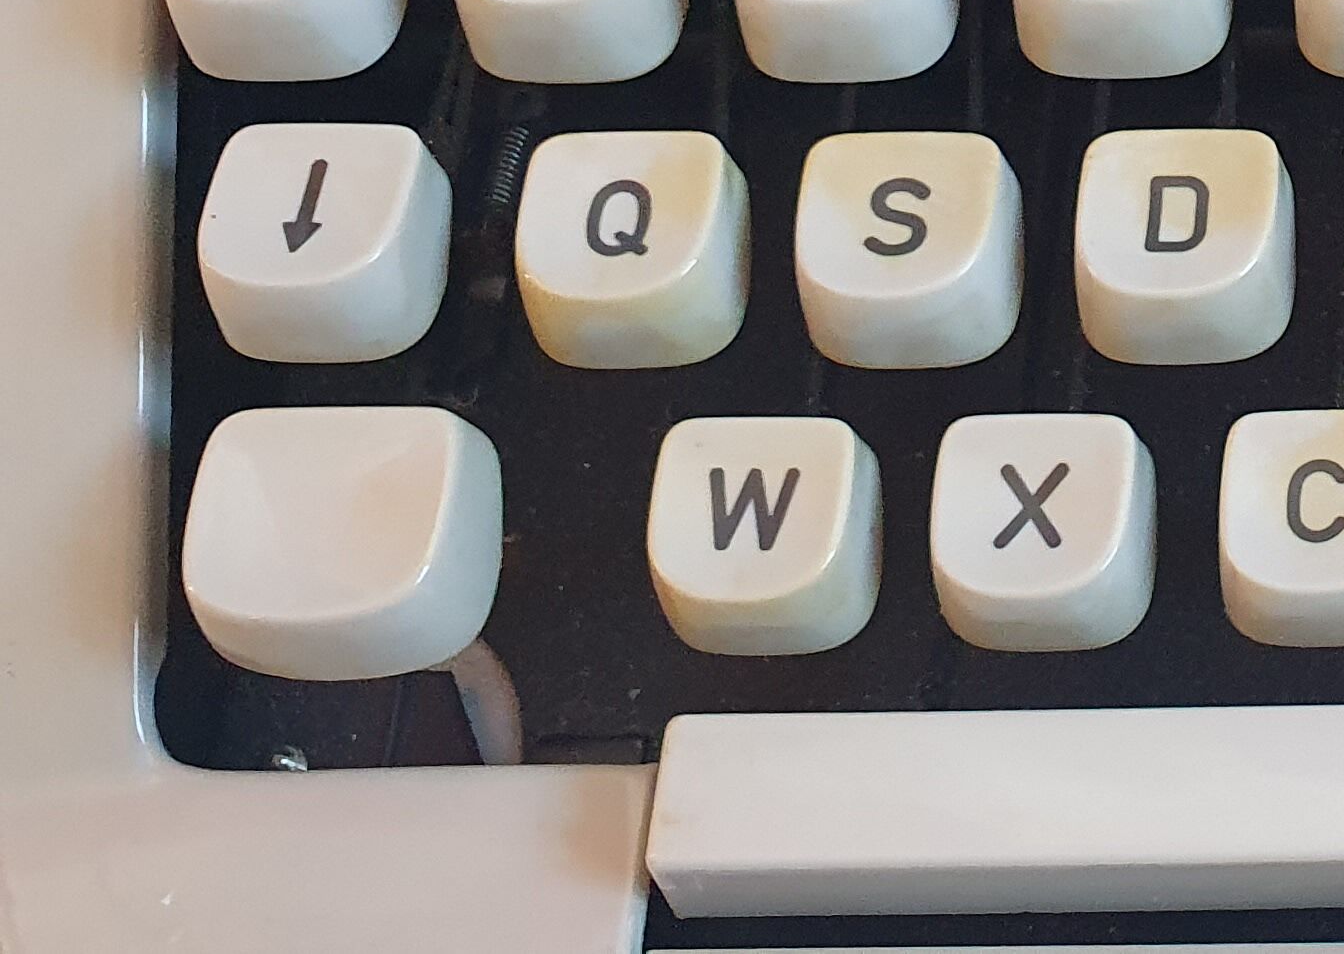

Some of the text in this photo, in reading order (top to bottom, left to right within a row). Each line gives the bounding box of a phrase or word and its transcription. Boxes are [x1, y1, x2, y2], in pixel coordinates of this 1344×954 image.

[584, 178, 654, 259] Q
[861, 175, 933, 258] S
[1142, 174, 1211, 254] D
[707, 466, 802, 553] W
[991, 461, 1072, 551] X
